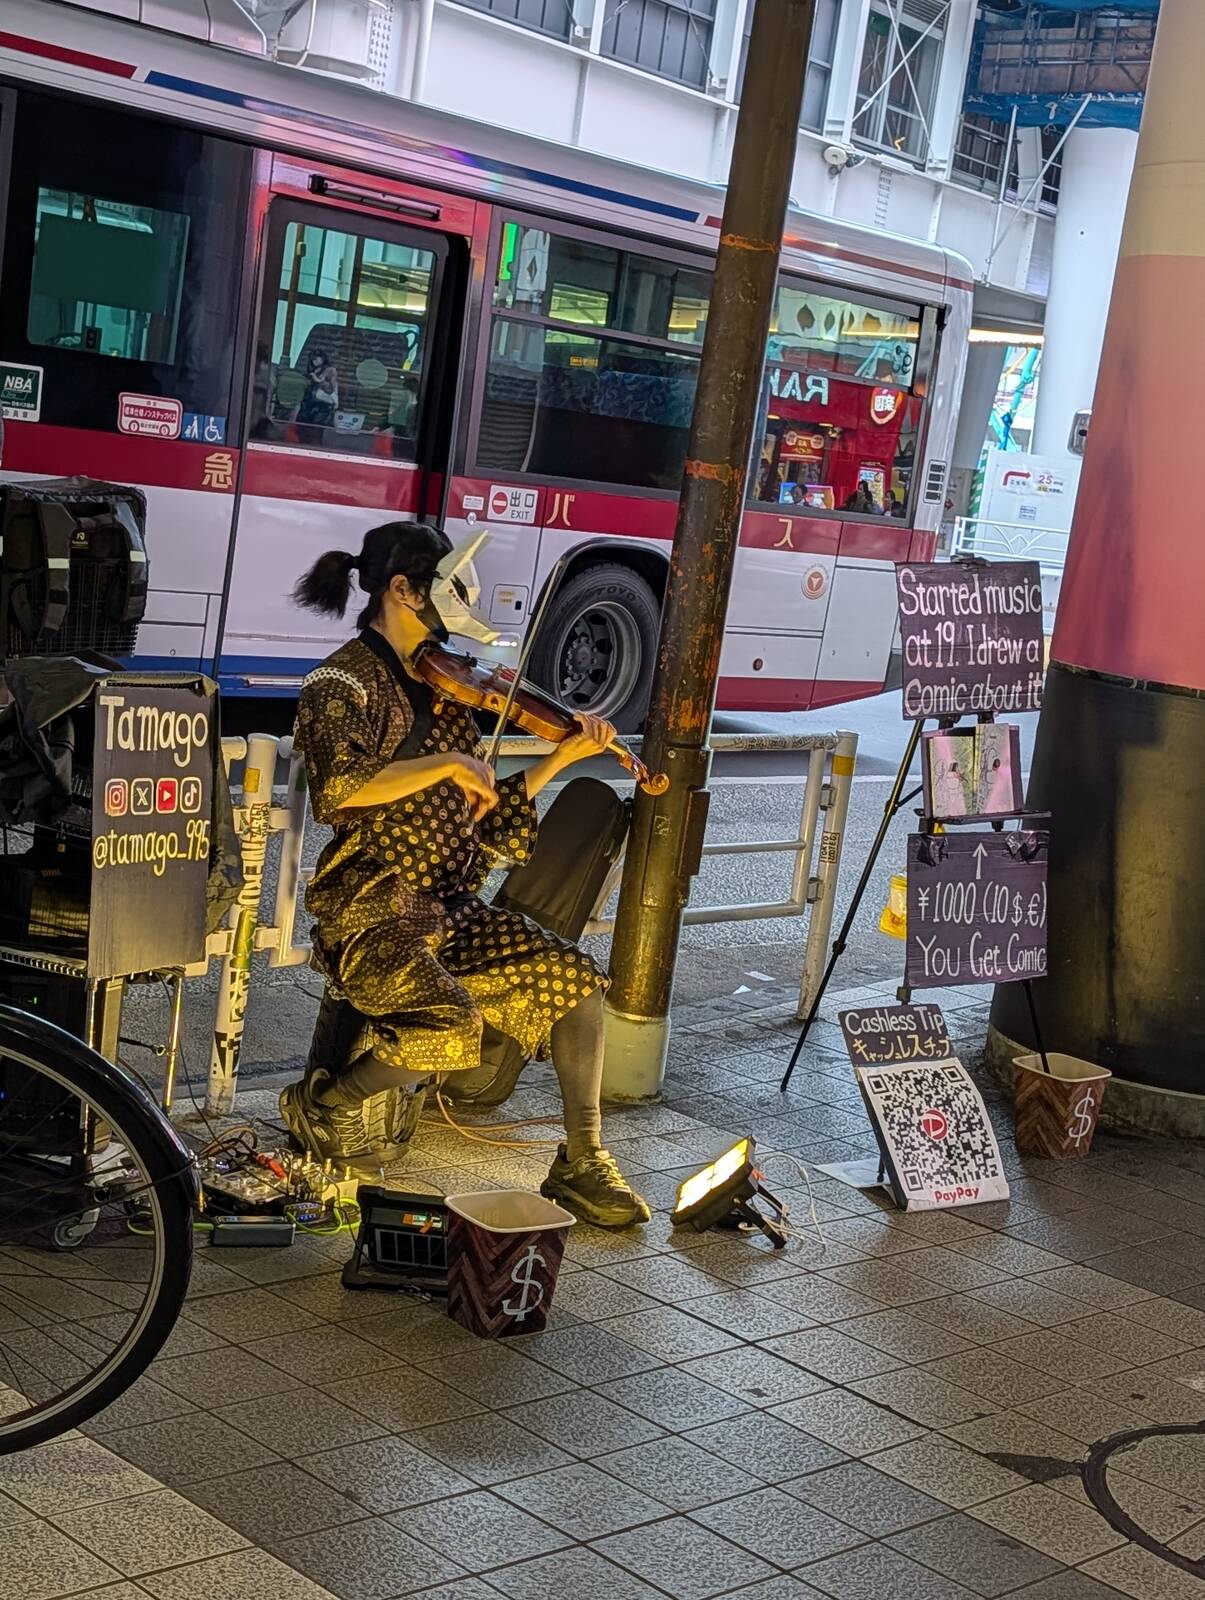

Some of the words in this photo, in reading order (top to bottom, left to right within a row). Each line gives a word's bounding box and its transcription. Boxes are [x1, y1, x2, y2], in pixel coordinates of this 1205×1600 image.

[4, 375, 32, 390] NBA
[201, 452, 233, 489] 急
[546, 493, 575, 526] バ
[773, 518, 794, 548] ス
[509, 491, 535, 508] 出口
[1039, 474, 1053, 485] 25
[510, 509, 530, 520] EXIT
[597, 585, 636, 600] TOYO
[900, 567, 982, 617] Started
[984, 577, 1042, 615] music
[905, 629, 933, 668] at
[934, 621, 960, 668] 19.
[966, 624, 976, 666] I
[976, 623, 1023, 666] drew
[1026, 638, 1040, 663] a
[904, 677, 968, 717] Comic
[970, 673, 1024, 711] about
[1026, 671, 1043, 709] it
[99, 695, 209, 768] Tamago
[93, 819, 211, 877] @tamago_995
[916, 934, 961, 977] You
[969, 931, 1002, 978] Get
[1007, 932, 1047, 973] Comic
[845, 1008, 917, 1035] Cashless
[913, 1006, 944, 1034] Tip
[852, 1034, 950, 1062] キャッシュレスチップ
[1068, 1087, 1096, 1147] $
[934, 1186, 980, 1203] PayPay
[501, 1245, 547, 1322] $
